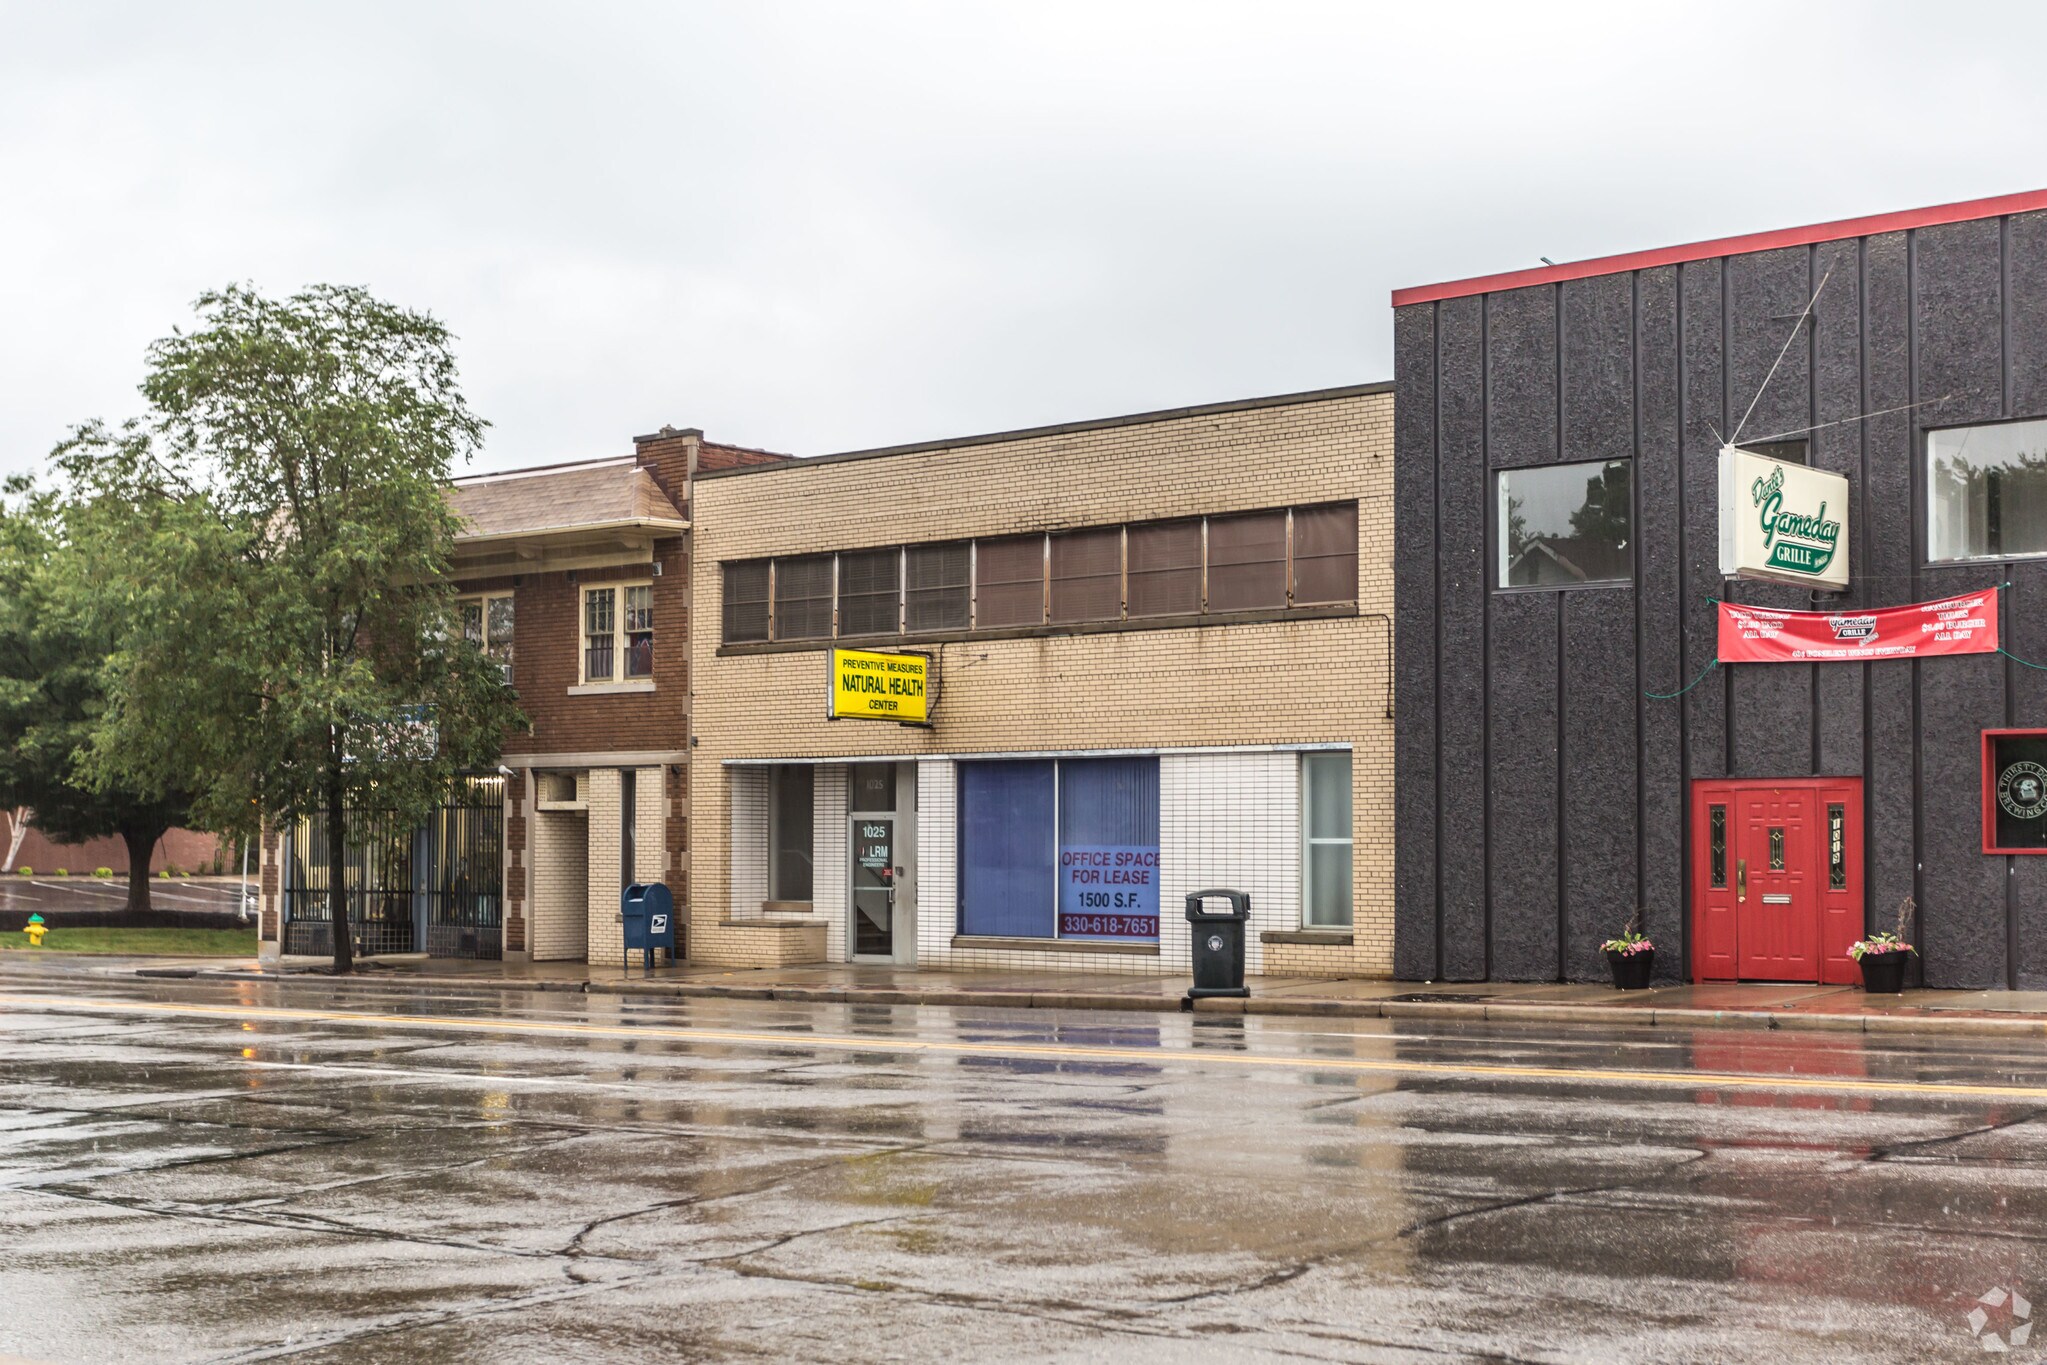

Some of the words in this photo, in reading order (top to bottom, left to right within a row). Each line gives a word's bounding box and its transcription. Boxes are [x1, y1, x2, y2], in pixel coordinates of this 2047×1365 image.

[1761, 489, 1840, 549] Gameday
[1777, 545, 1812, 565] GRILLE
[1946, 618, 1986, 630] BURGER
[1743, 630, 1759, 639] ALL
[1760, 630, 1779, 639] DAY
[1842, 629, 1867, 637] GRILLE
[1934, 631, 1952, 641] ALL
[1953, 630, 1972, 640] DAY
[842, 658, 885, 671] PREVENTIVE
[887, 662, 923, 674] MEASURES
[842, 673, 886, 694] NATURAL
[888, 677, 924, 697] HEALTH
[868, 699, 898, 711] CENTER
[2000, 763, 2036, 788] THIRSTY
[866, 779, 884, 789] 1025
[2000, 790, 2041, 817] BREWING
[862, 826, 886, 838] 1025
[1832, 818, 1841, 864] 1019
[869, 845, 888, 857] LRM
[1062, 852, 1111, 866] OFFICE
[1115, 852, 1160, 867] SPACE
[1072, 870, 1099, 884] FOR
[1104, 870, 1149, 884] LEASE
[1079, 892, 1110, 908] 1500
[1114, 893, 1141, 908] S.F.
[1064, 916, 1155, 934] 330-618-7651
